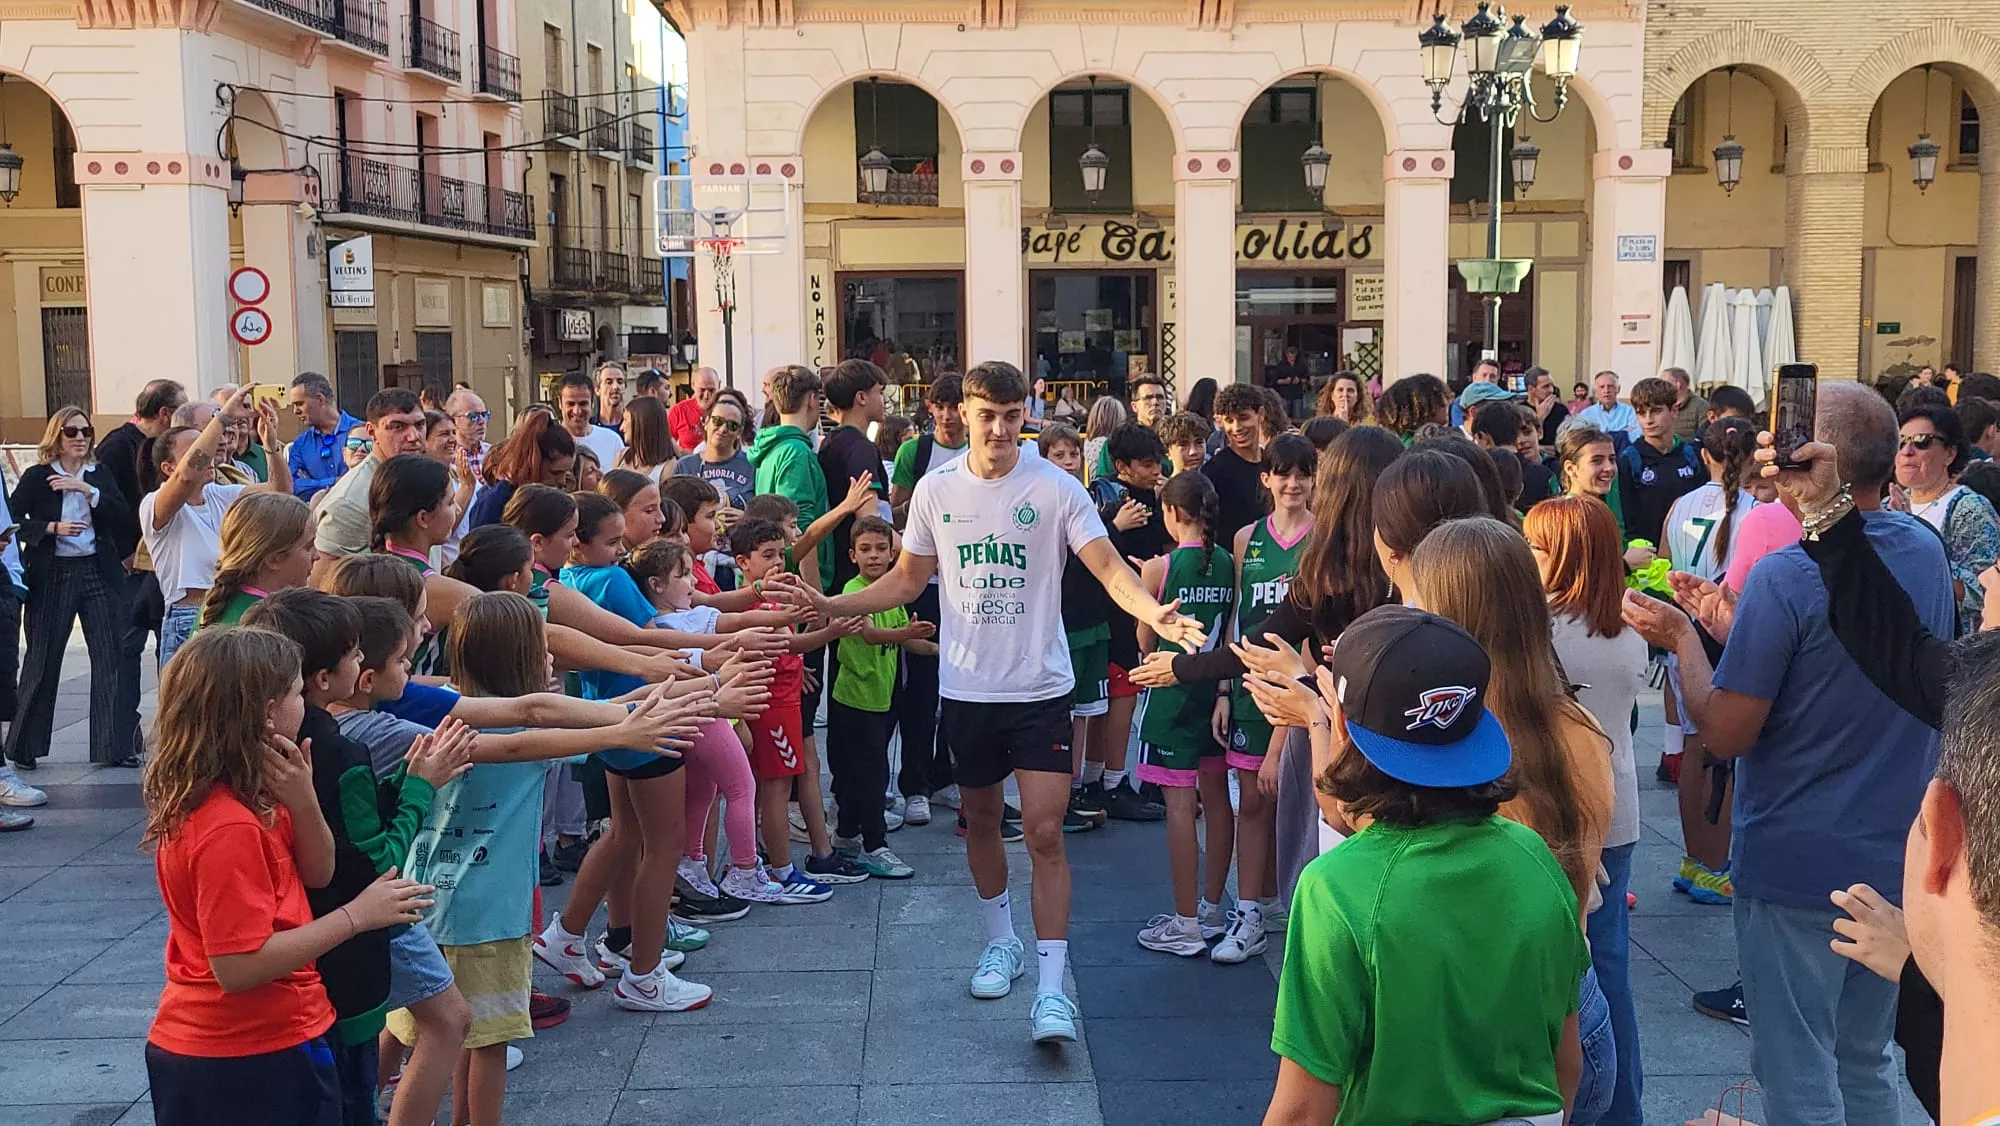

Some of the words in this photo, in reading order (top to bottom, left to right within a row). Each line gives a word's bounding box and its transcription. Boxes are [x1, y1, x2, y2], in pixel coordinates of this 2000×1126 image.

[334, 266, 368, 275] VELTINS
[810, 274, 821, 302] NO
[1690, 517, 1717, 567] 7
[960, 572, 1026, 589] Lobe
